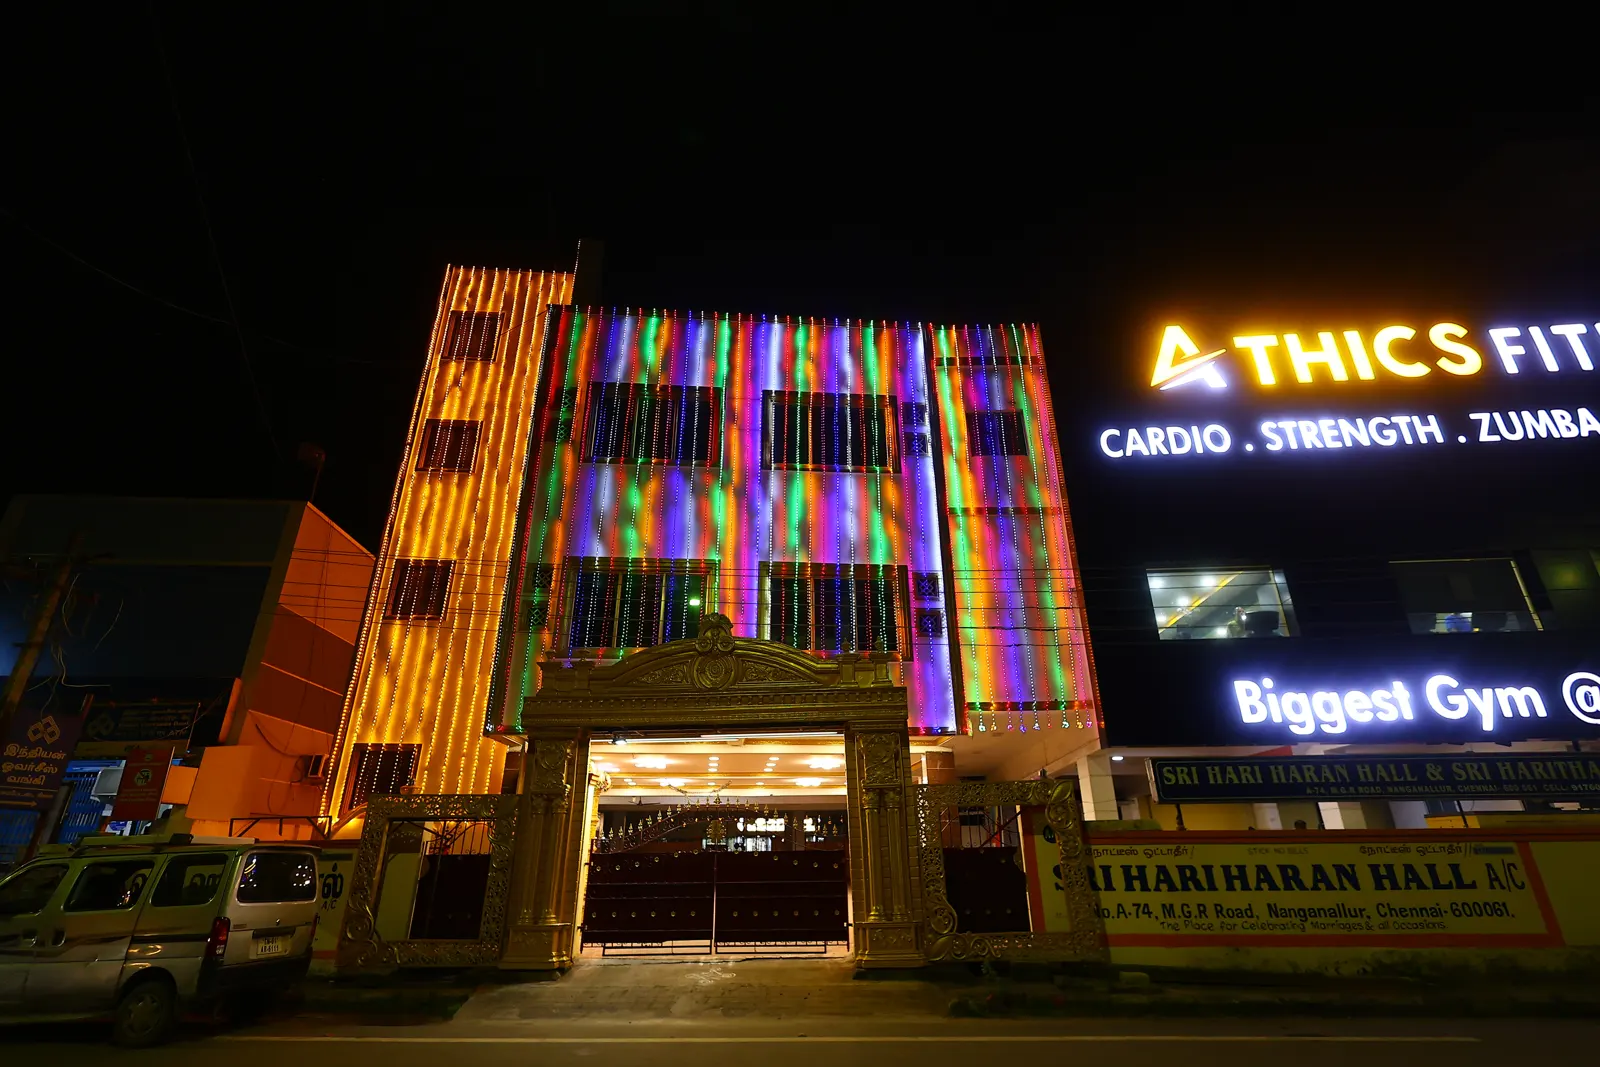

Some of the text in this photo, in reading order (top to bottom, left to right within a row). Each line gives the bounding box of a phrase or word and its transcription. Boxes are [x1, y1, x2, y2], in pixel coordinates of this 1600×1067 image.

[1488, 323, 1600, 374] FIT
[1100, 424, 1231, 458] CARDIO
[1261, 415, 1445, 452] STRENGTH
[1468, 407, 1600, 443] ZUMBA
[1233, 677, 1414, 735] Biggest
[1425, 674, 1548, 732] Gym
[4, 743, 67, 760] இந்தியன்
[7, 774, 46, 786] வங்கி
[1163, 766, 1200, 785] SRI
[1206, 765, 1263, 785] HARI
[1269, 764, 1350, 784] HARAN
[1357, 763, 1418, 782] HALL
[1426, 762, 1444, 781] &
[1453, 762, 1492, 780] SRI
[1368, 863, 1477, 891] HALL
[1485, 859, 1525, 892] A/C
[1161, 903, 1209, 919] M.G.R
[1214, 903, 1259, 920] Road,
[1267, 903, 1371, 922] Nanganallur,
[1160, 921, 1180, 931] The
[1184, 920, 1213, 931] Place
[1220, 921, 1237, 931] for
[1241, 921, 1306, 932] Celebrating
[1378, 921, 1390, 931] all
